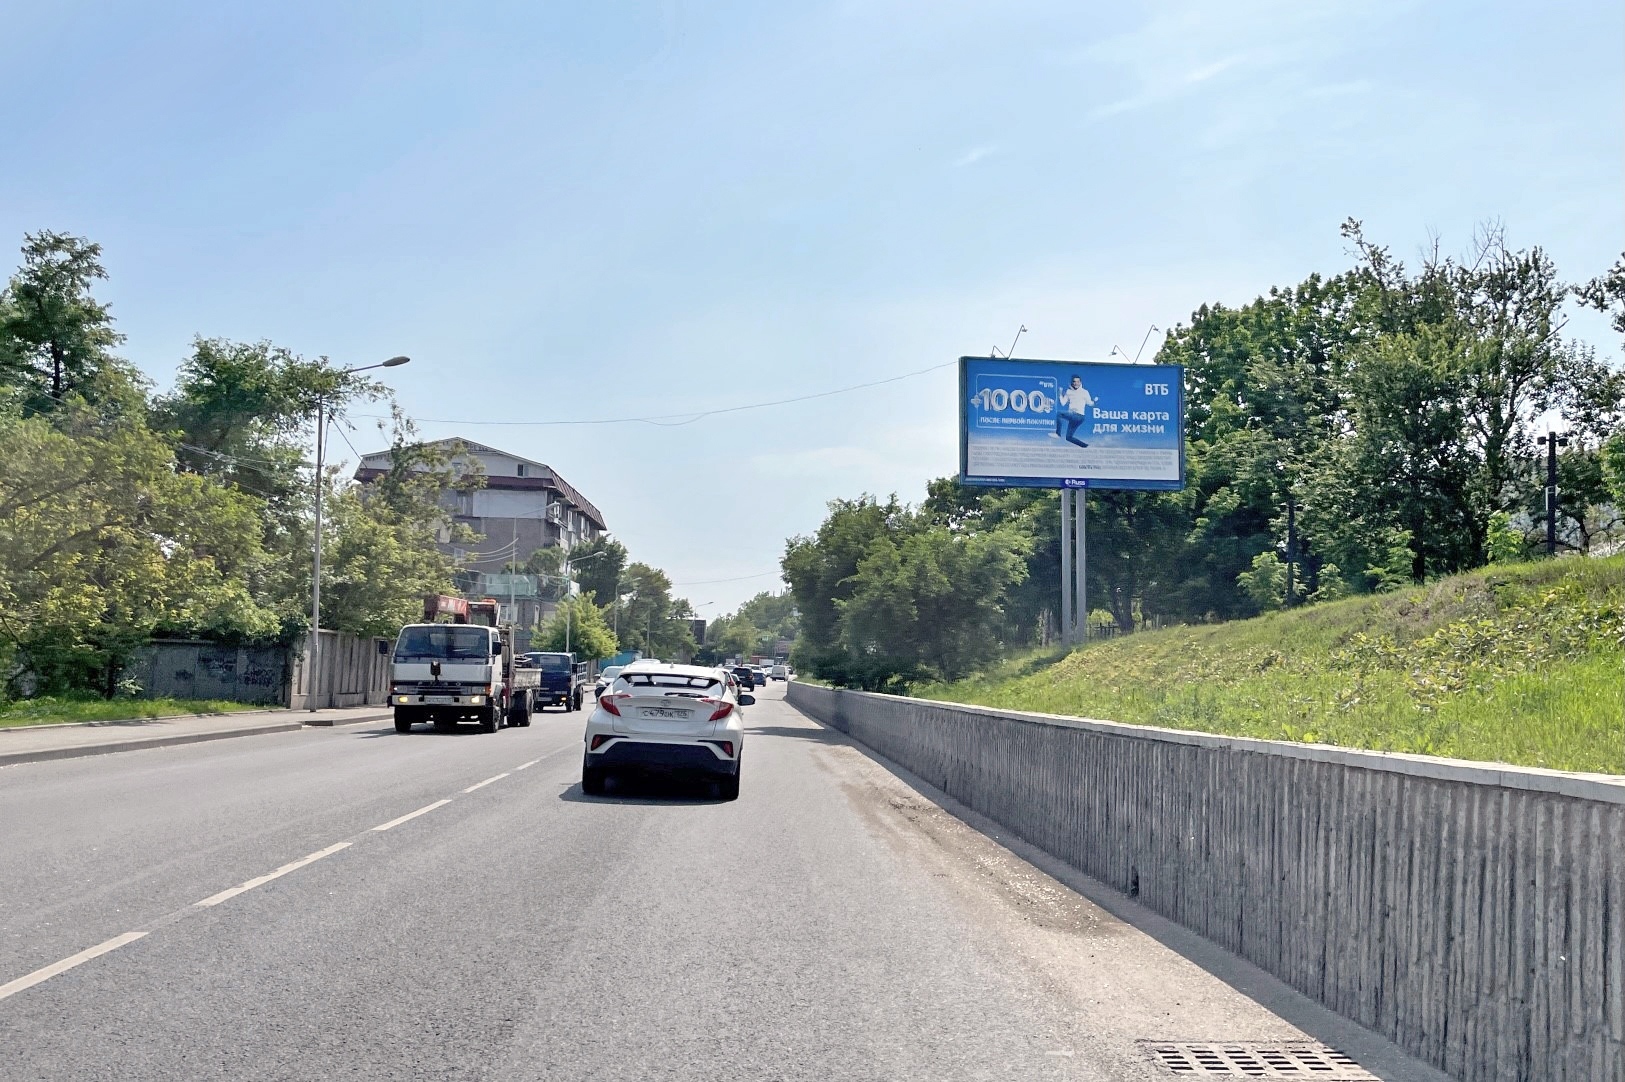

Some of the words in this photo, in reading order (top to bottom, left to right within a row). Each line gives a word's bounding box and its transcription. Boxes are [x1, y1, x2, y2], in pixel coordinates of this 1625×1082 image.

[1144, 383, 1169, 396] ВТБ
[980, 416, 1001, 424] ПОСЛЕ
[1026, 418, 1055, 426] ПОКУПКИ
[1093, 407, 1129, 420] Ваша
[1132, 411, 1170, 424] карта
[1093, 423, 1118, 434] для
[1120, 424, 1165, 434] жизни
